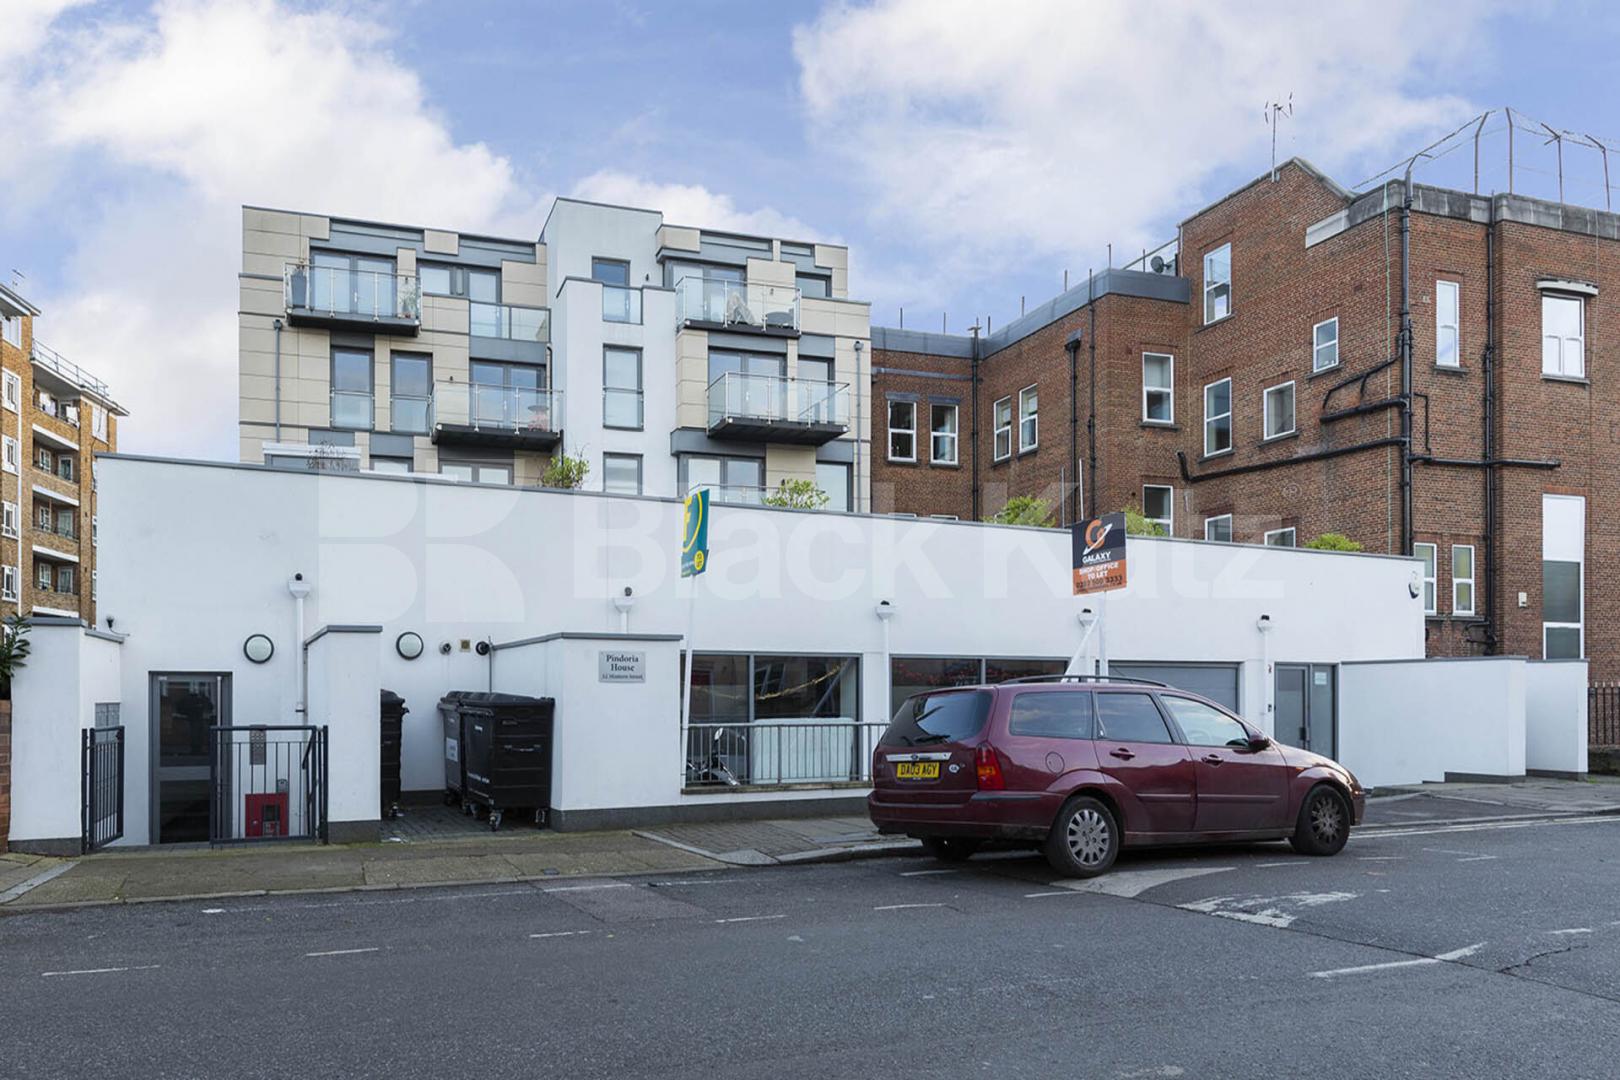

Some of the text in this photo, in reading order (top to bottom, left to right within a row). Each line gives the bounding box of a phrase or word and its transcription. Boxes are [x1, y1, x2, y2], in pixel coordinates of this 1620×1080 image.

[1082, 551, 1111, 564] GALAXY
[1096, 570, 1108, 579] LET
[606, 654, 639, 662] Pindoria
[611, 663, 634, 671] House
